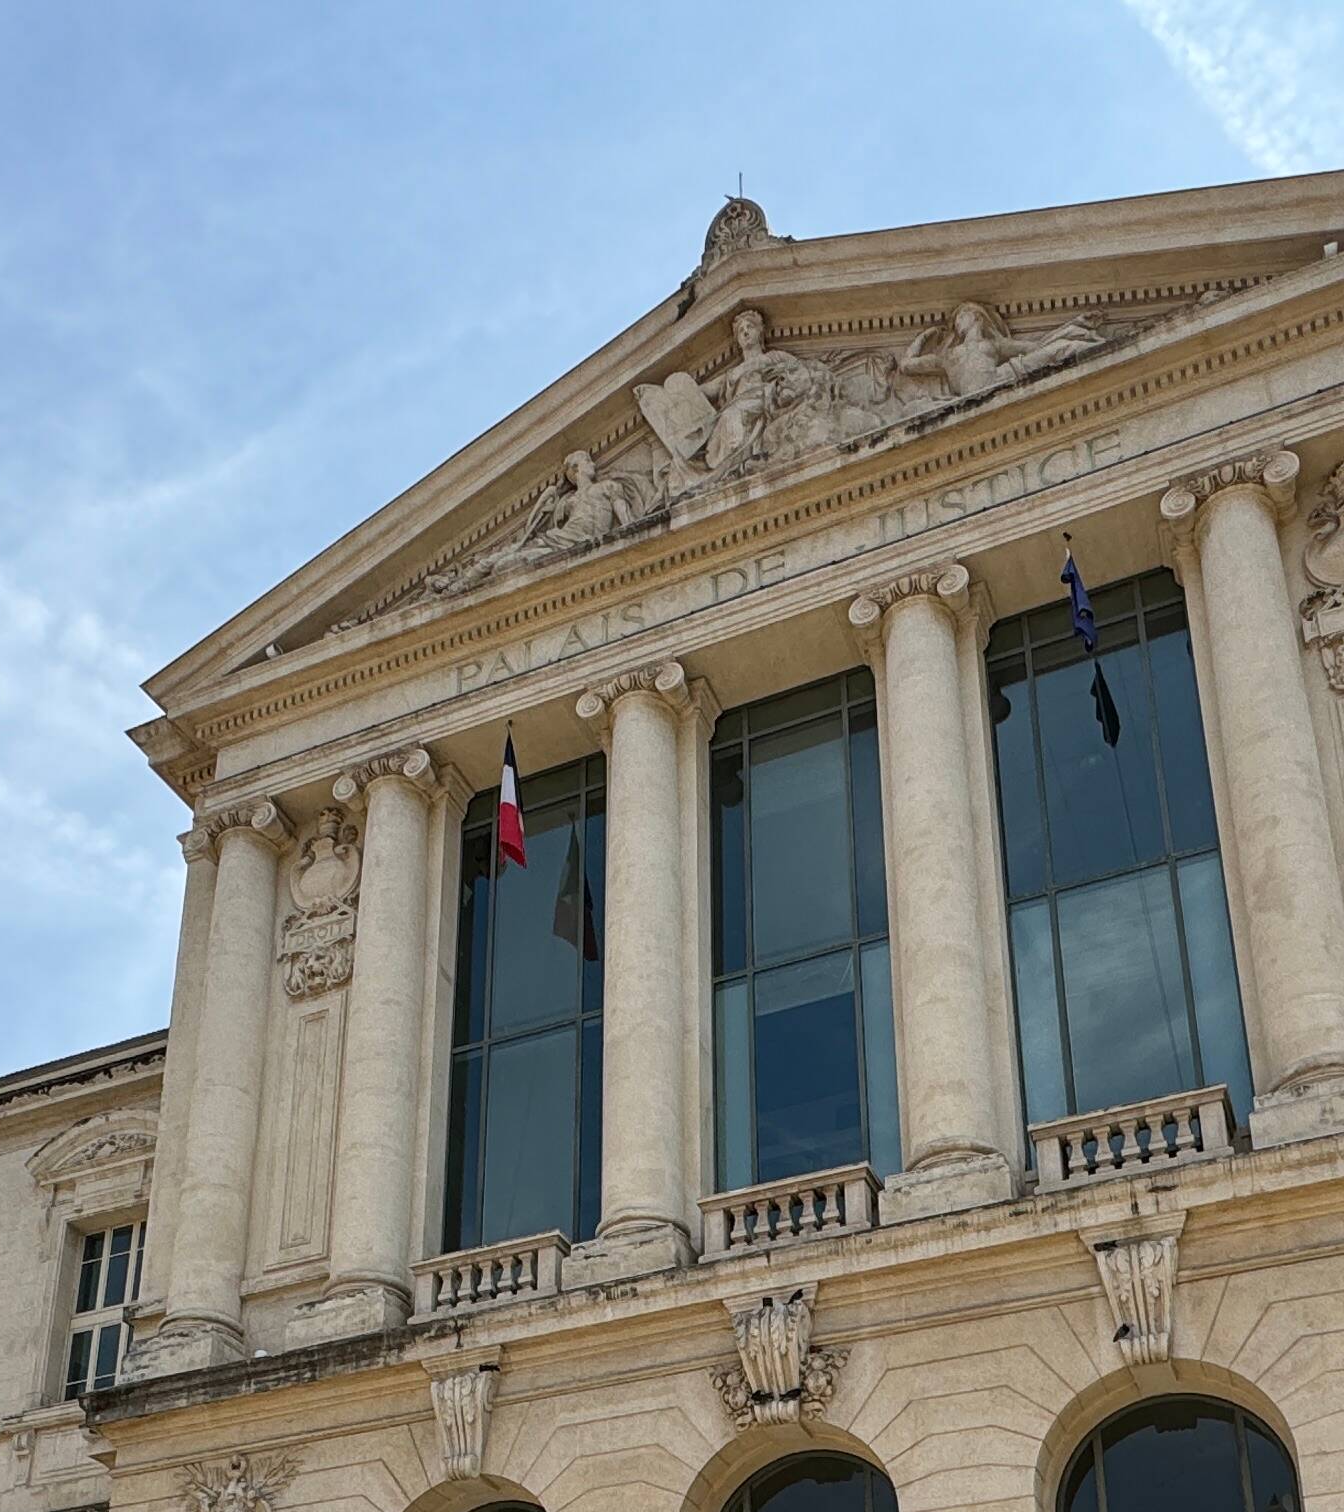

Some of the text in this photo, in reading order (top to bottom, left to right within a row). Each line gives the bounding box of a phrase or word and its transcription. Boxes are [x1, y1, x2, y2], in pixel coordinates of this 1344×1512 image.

[454, 428, 1122, 694] PALAIS DE JUSTICE
[296, 922, 345, 947] DROIT
